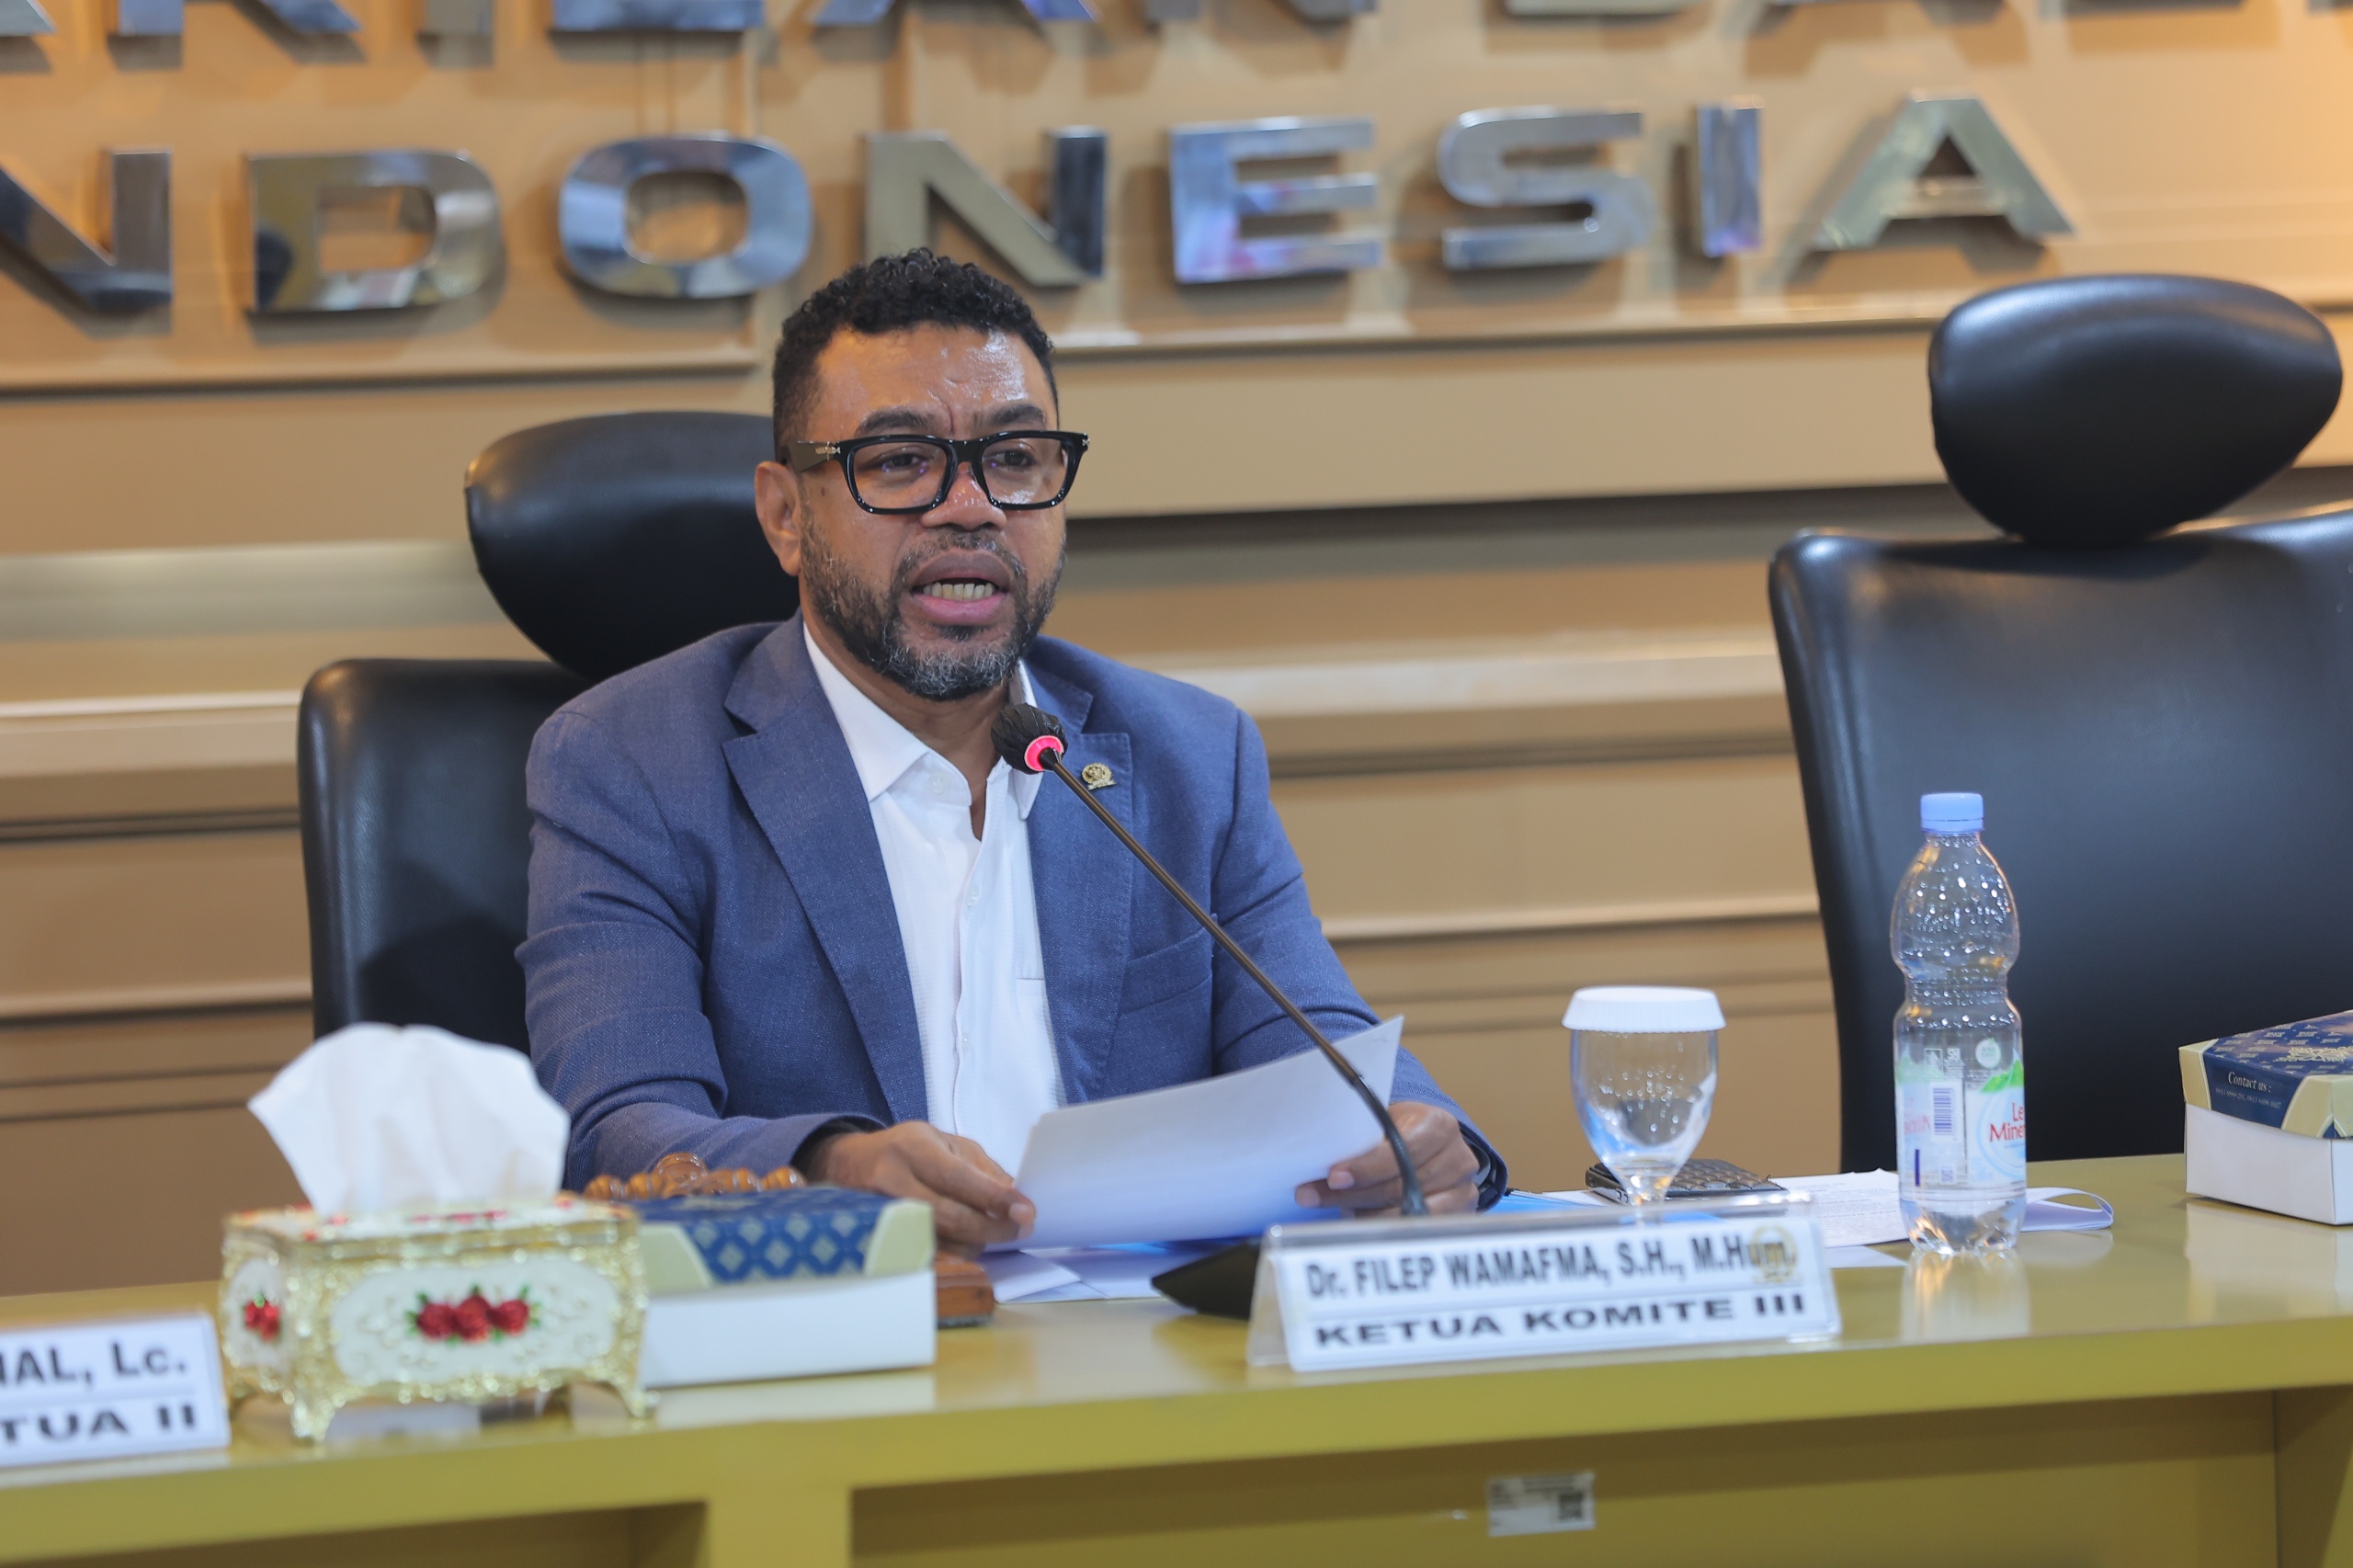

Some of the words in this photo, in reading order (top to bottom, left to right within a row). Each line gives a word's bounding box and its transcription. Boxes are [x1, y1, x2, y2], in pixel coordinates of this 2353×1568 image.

[2228, 1071, 2257, 1090] Contact
[1306, 1263, 1348, 1299] Dr.
[1353, 1256, 1435, 1295] FILEP
[1445, 1244, 1611, 1289] WAMAFMA,
[1617, 1237, 1686, 1280] S.H.,
[1315, 1315, 1503, 1347] KETUA
[1523, 1298, 1734, 1333] KOMITE
[1754, 1292, 1805, 1318] III
[0, 1346, 93, 1392] AL,
[111, 1341, 187, 1377] Lc.
[157, 1403, 196, 1432] II
